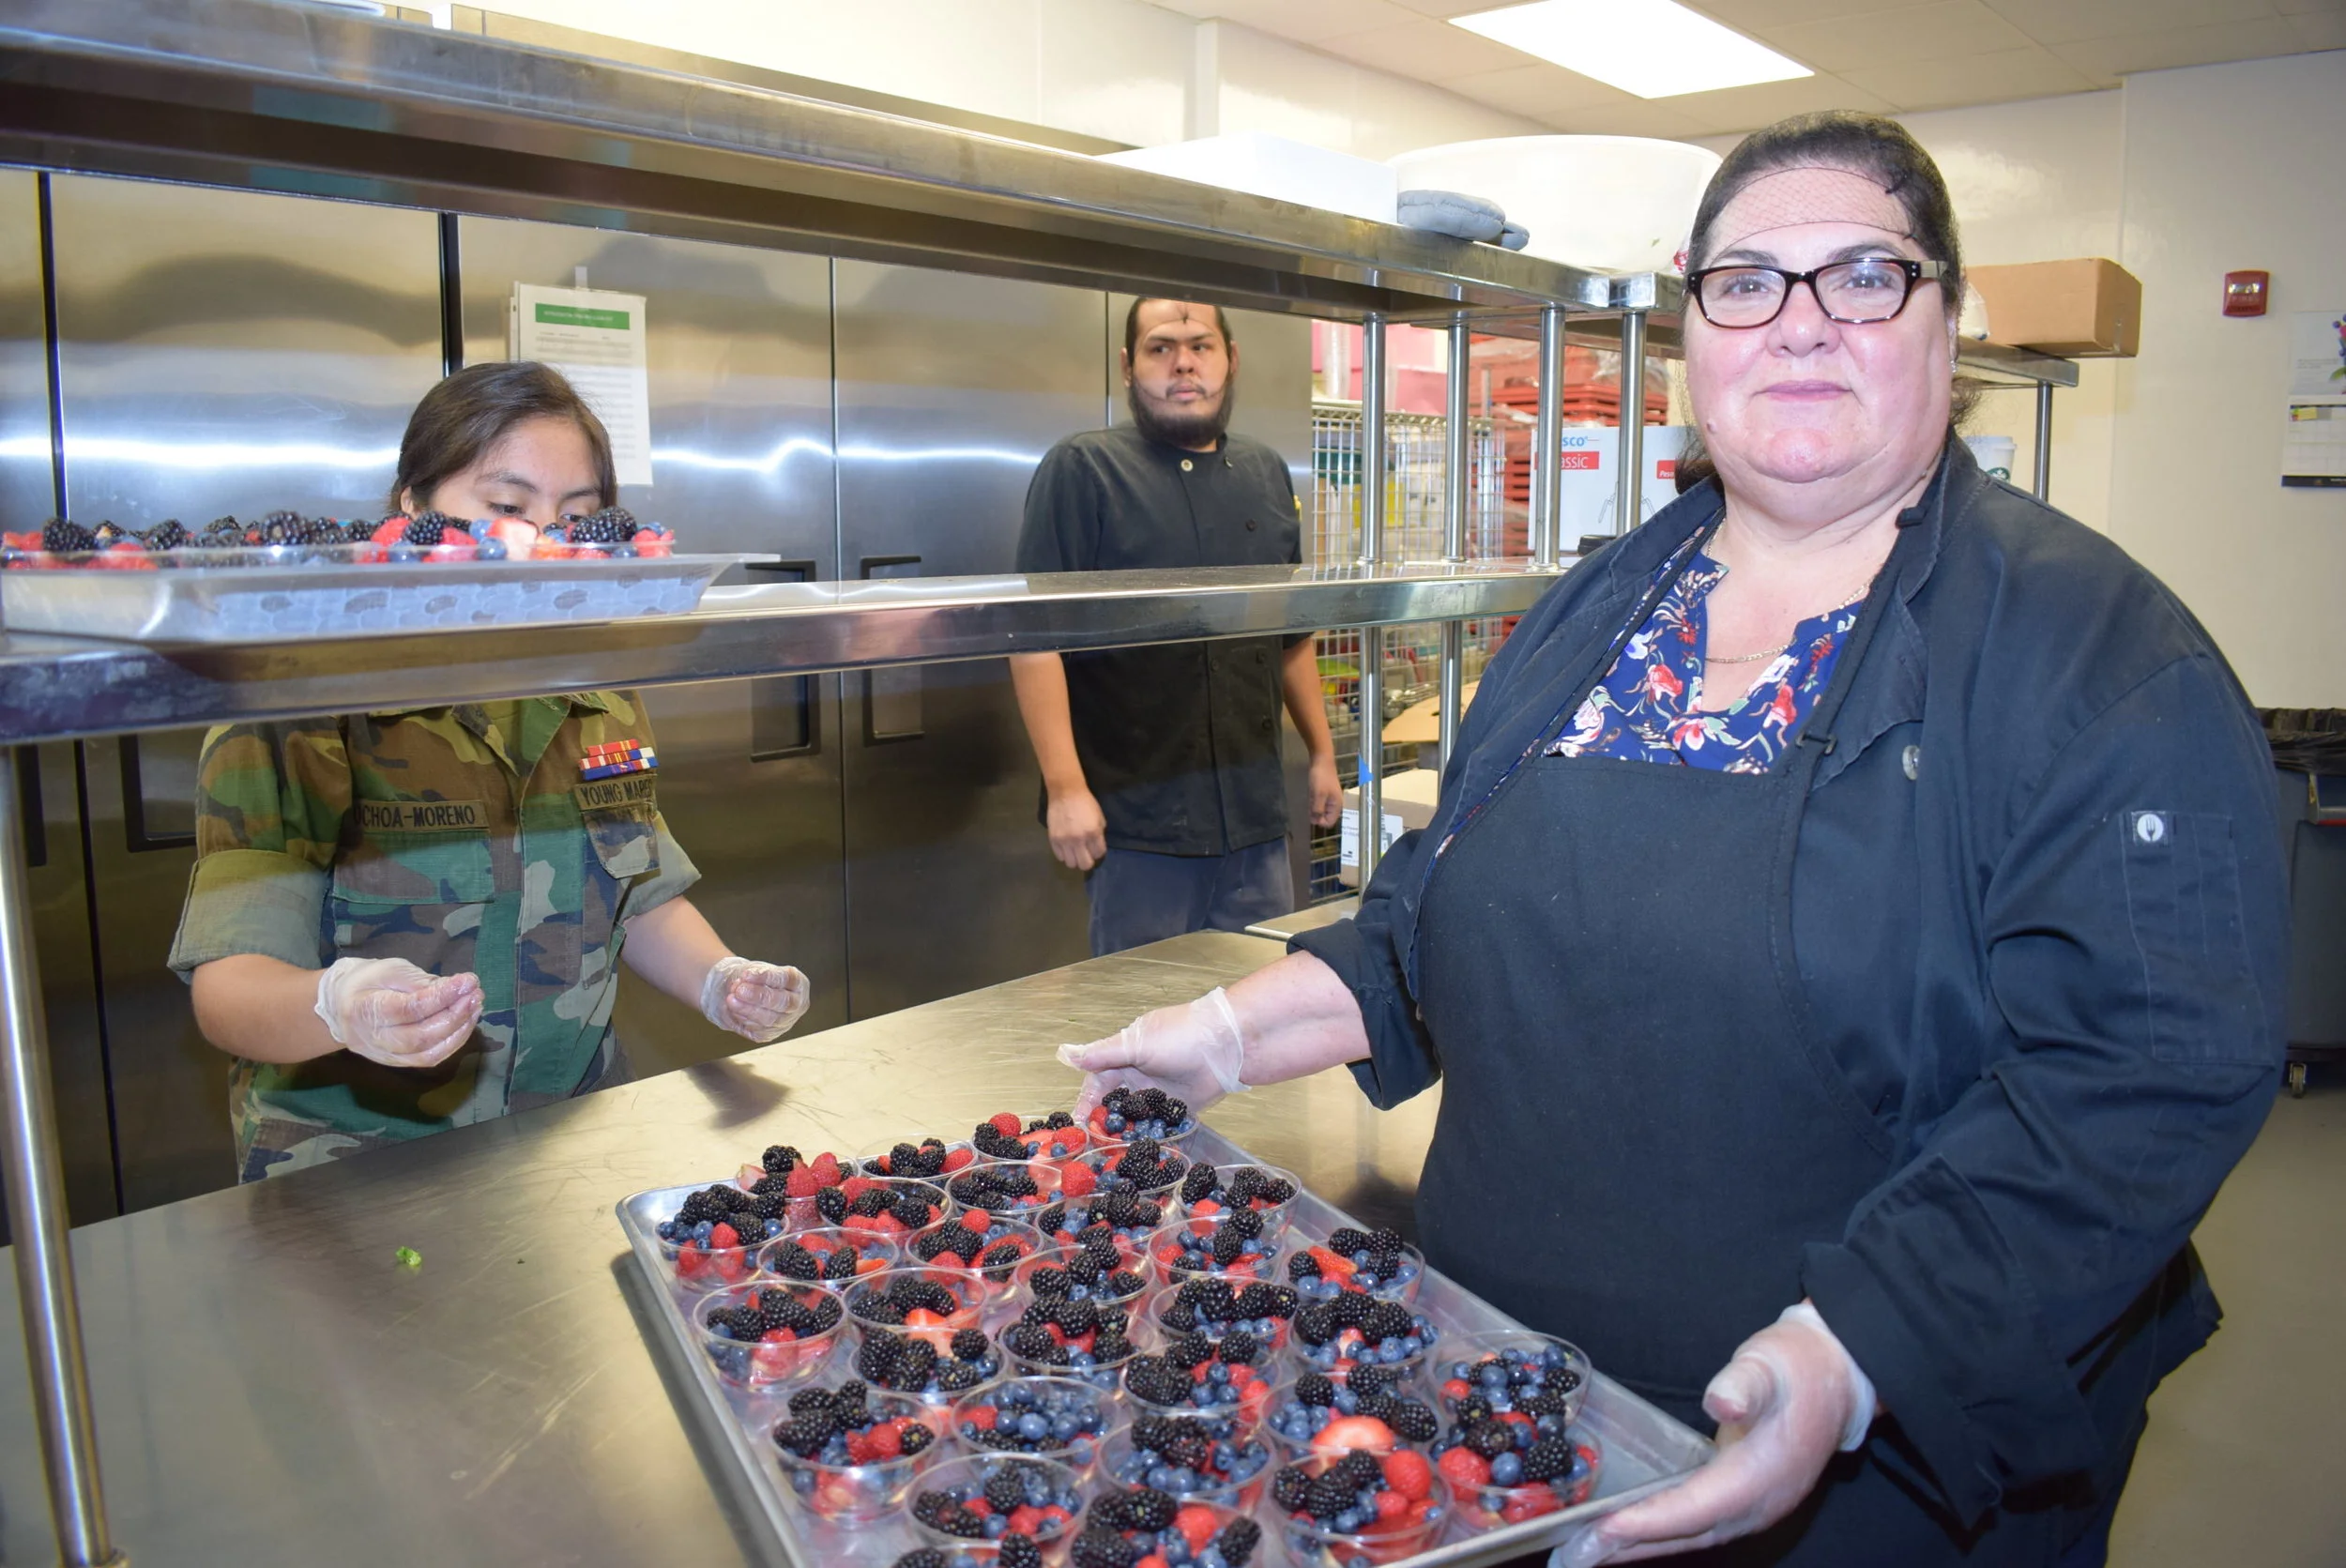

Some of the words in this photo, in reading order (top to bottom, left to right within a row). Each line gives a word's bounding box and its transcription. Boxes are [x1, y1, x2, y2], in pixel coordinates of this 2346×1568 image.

[1561, 436, 1585, 447] sco
[1561, 453, 1589, 468] assic
[580, 783, 623, 806] YOUNG
[353, 805, 476, 828] OCHOA-MORENO
